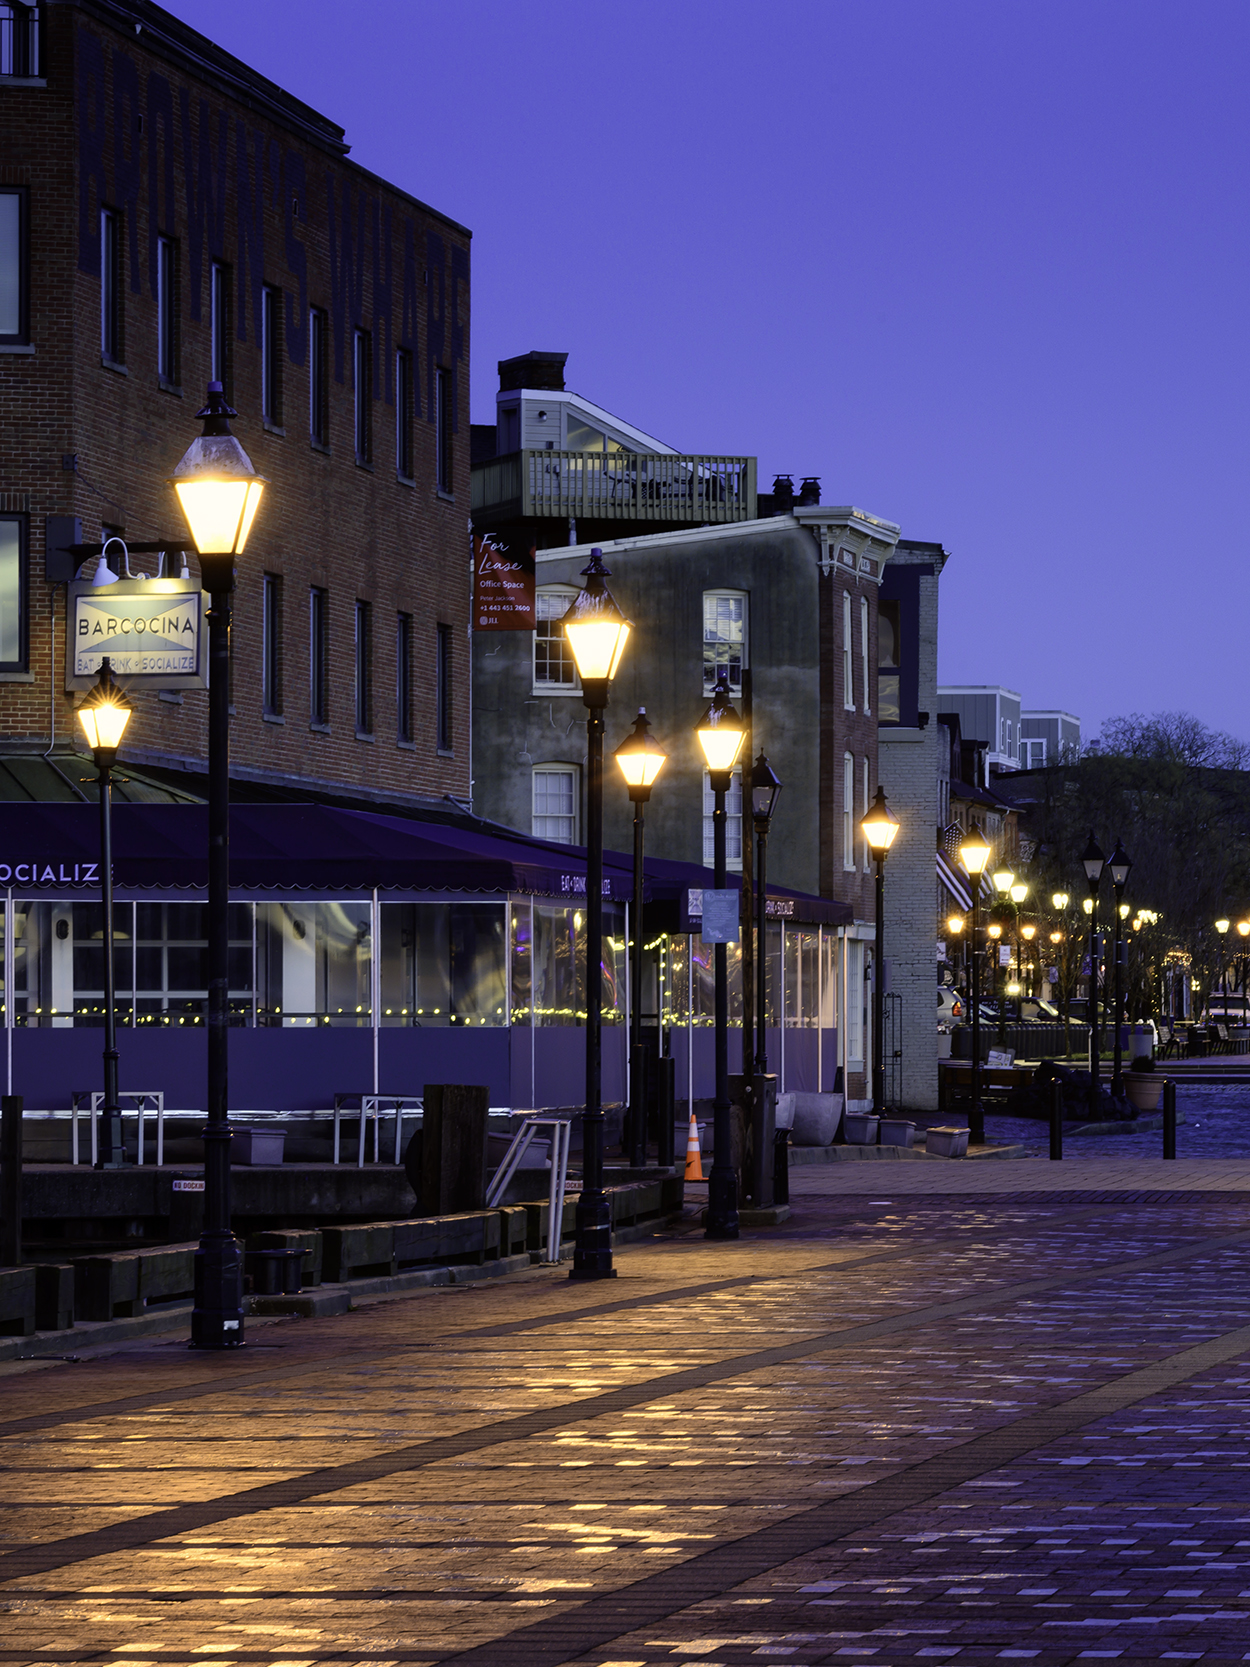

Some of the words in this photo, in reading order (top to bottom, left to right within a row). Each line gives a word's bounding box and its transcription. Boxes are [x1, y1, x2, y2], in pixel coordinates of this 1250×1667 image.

[325, 170, 470, 433] WHARF
[479, 532, 510, 553] For
[478, 553, 523, 575] Lease
[480, 580, 501, 588] Office
[503, 580, 525, 589] Space
[79, 616, 195, 636] BARCOCINA
[77, 658, 94, 672] EAT
[109, 657, 132, 671] RINK
[142, 656, 194, 670] SOCIALIZE
[0, 863, 114, 882] OCIALIZ
[183, 1181, 205, 1189] DOCKIN
